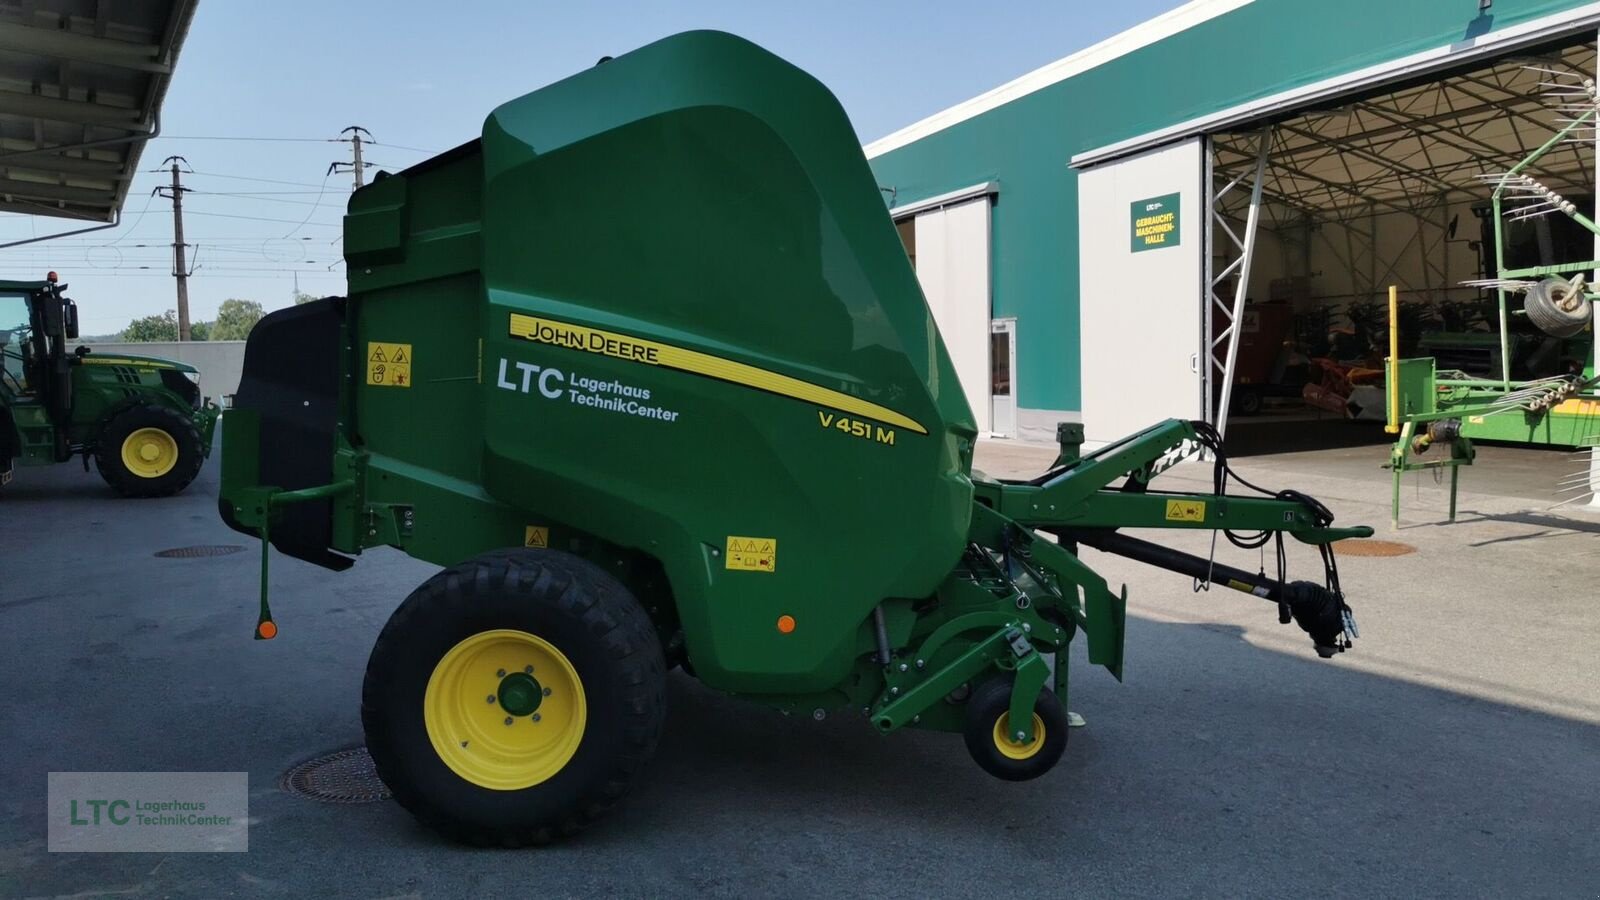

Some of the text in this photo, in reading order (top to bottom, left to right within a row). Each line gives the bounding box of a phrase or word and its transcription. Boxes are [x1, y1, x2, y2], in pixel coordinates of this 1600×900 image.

[1136, 212, 1174, 227] GEBRAUCHT-
[1136, 222, 1174, 237] MASCHINEN-
[1145, 233, 1165, 244] HALLE
[528, 322, 659, 362] JOHN DEERE
[497, 358, 565, 399] LTC
[569, 372, 651, 400] Lagerhaus
[568, 389, 679, 422] TechnikCenter
[818, 411, 895, 445] V 451 M
